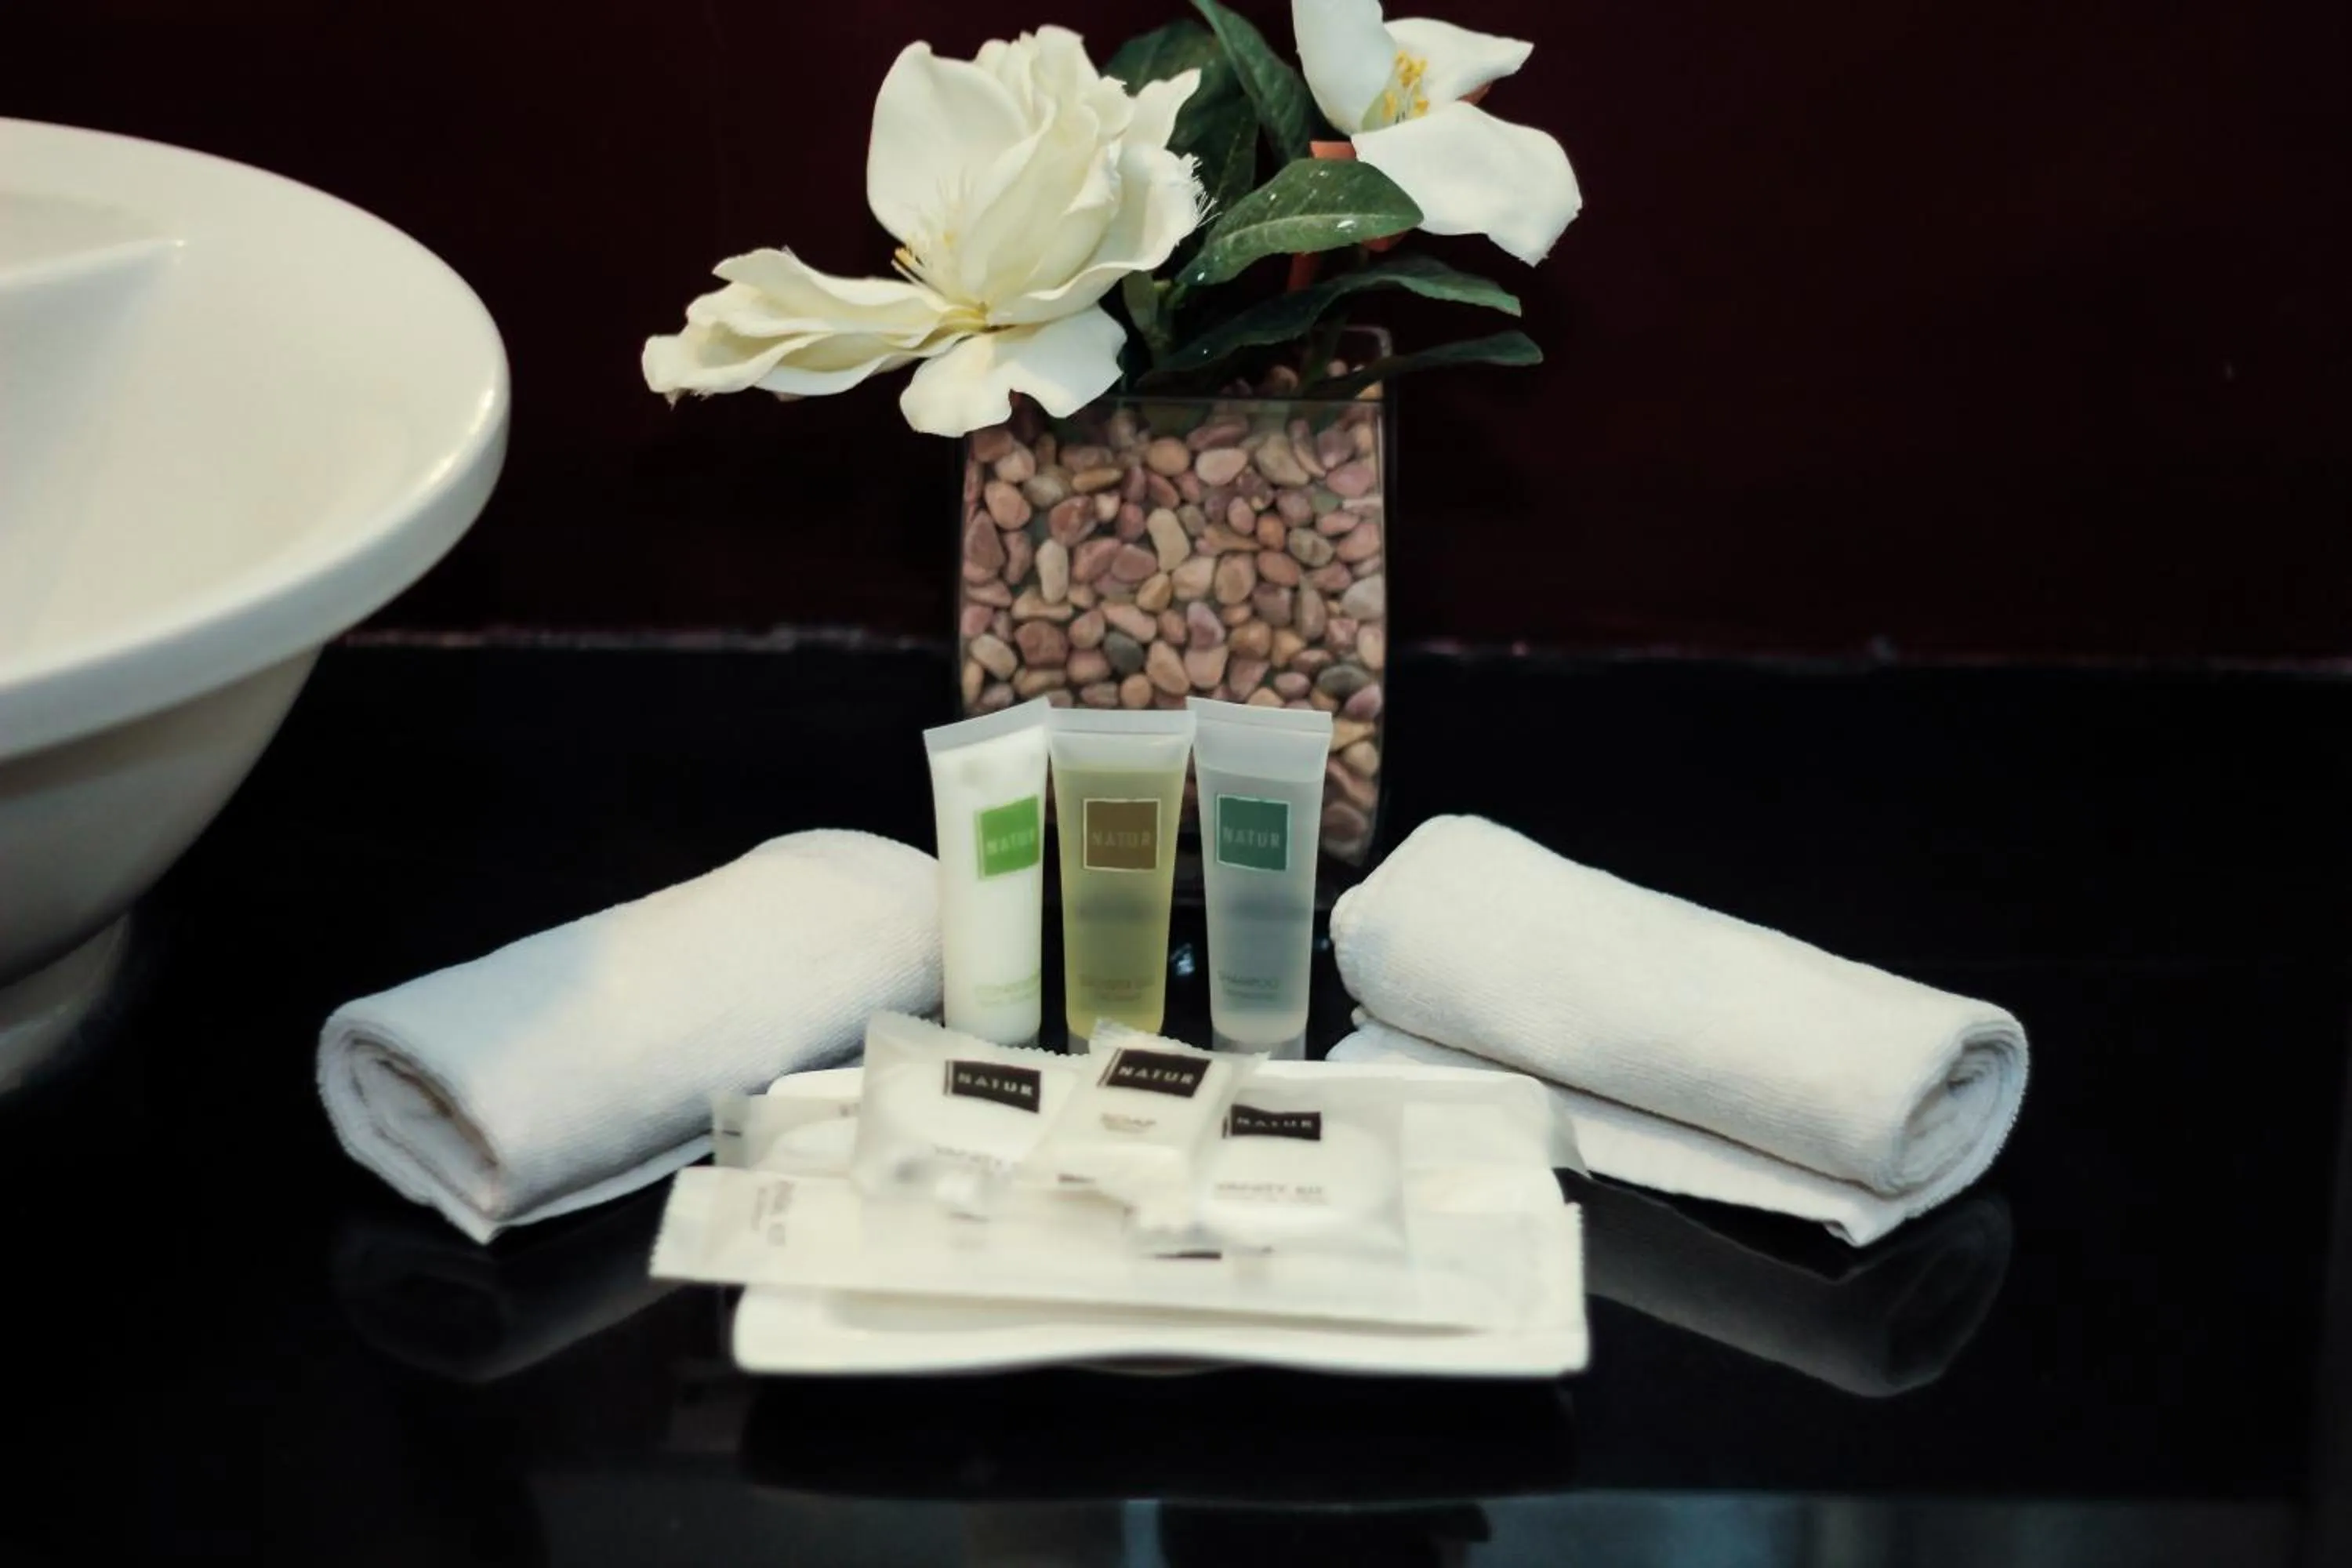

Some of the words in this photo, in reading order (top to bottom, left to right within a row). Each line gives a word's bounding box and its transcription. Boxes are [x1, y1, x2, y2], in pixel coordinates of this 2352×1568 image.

[1092, 830, 1151, 848] NATUR
[1223, 826, 1279, 848] NATUR
[957, 1072, 1033, 1096] NATUR
[1119, 1065, 1195, 1085] NATUR
